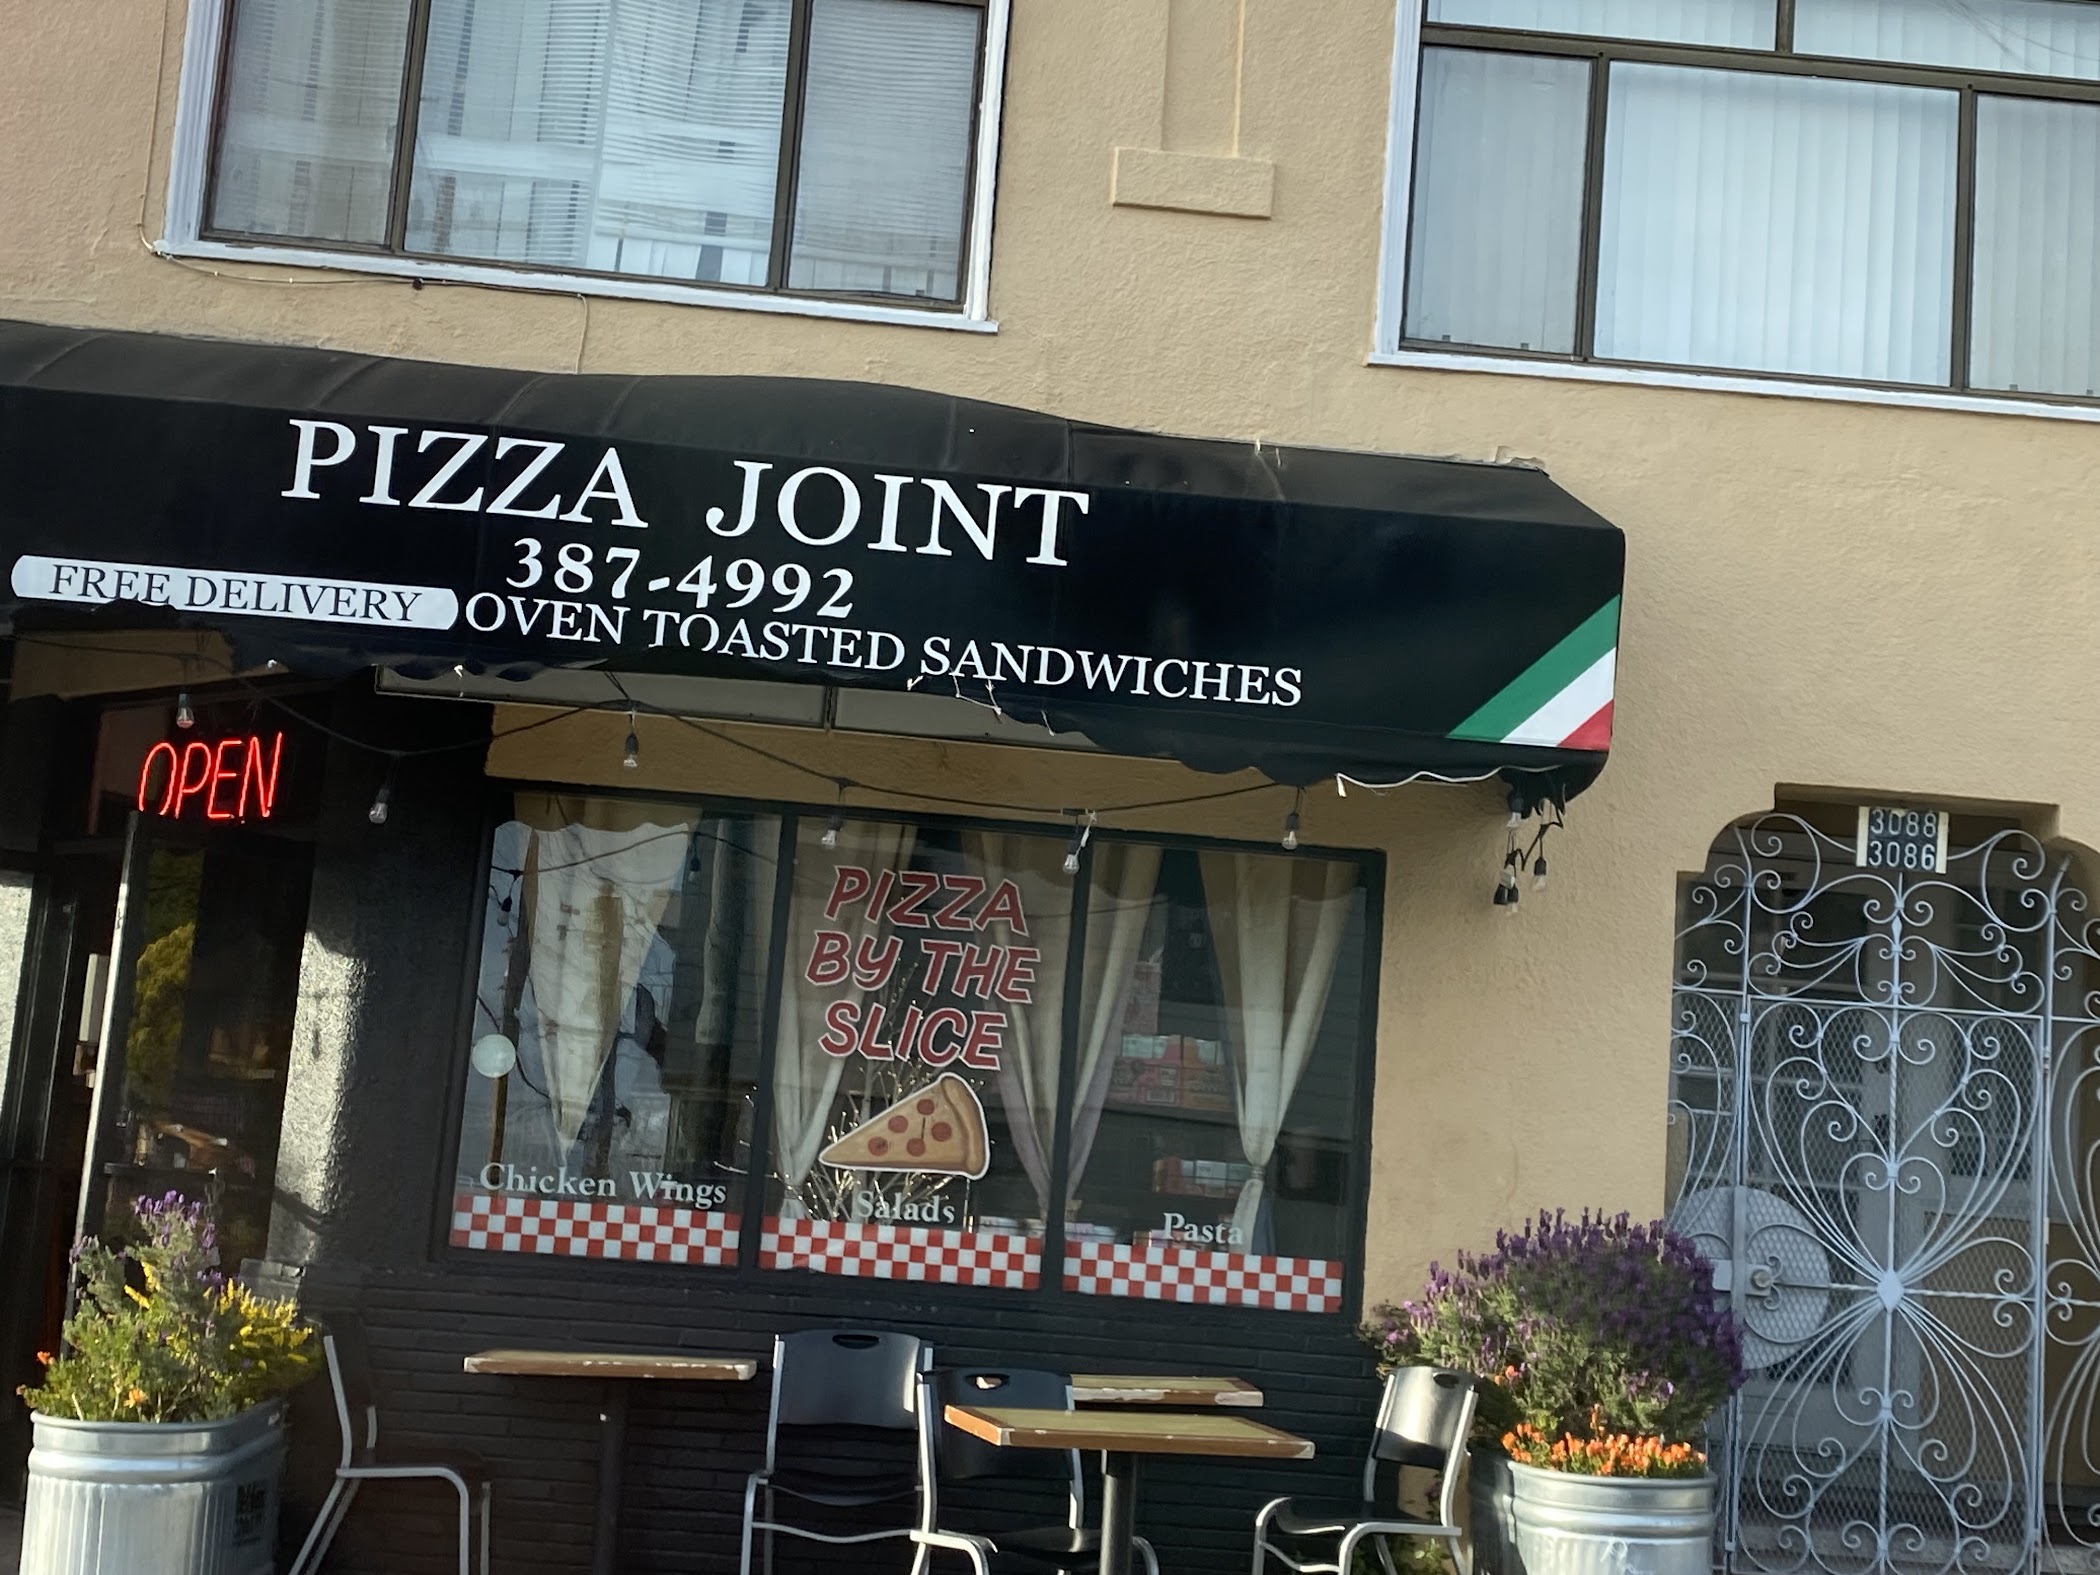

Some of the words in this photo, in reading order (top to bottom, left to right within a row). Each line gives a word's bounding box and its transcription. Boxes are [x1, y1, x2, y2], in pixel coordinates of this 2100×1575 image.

[280, 418, 649, 529] PIZZA
[705, 459, 1089, 567] JOINT
[49, 563, 171, 604] FREE
[186, 575, 422, 622] DELIVERY
[506, 537, 854, 619] 387-4992
[465, 591, 631, 645] OVEN
[643, 608, 906, 671] TOASTED
[920, 635, 1302, 707] SANDWICHES
[137, 731, 283, 820] OPEN
[1868, 840, 1936, 871] 3086
[1870, 808, 1937, 838] 3088
[824, 865, 1030, 938] PIZZA
[920, 938, 1042, 1004] THE
[818, 1000, 1009, 1071] SLICE
[479, 1162, 617, 1198] Chicken
[629, 1170, 728, 1210] Wings
[856, 1190, 957, 1225] Salads
[1162, 1211, 1245, 1246] Pasta
